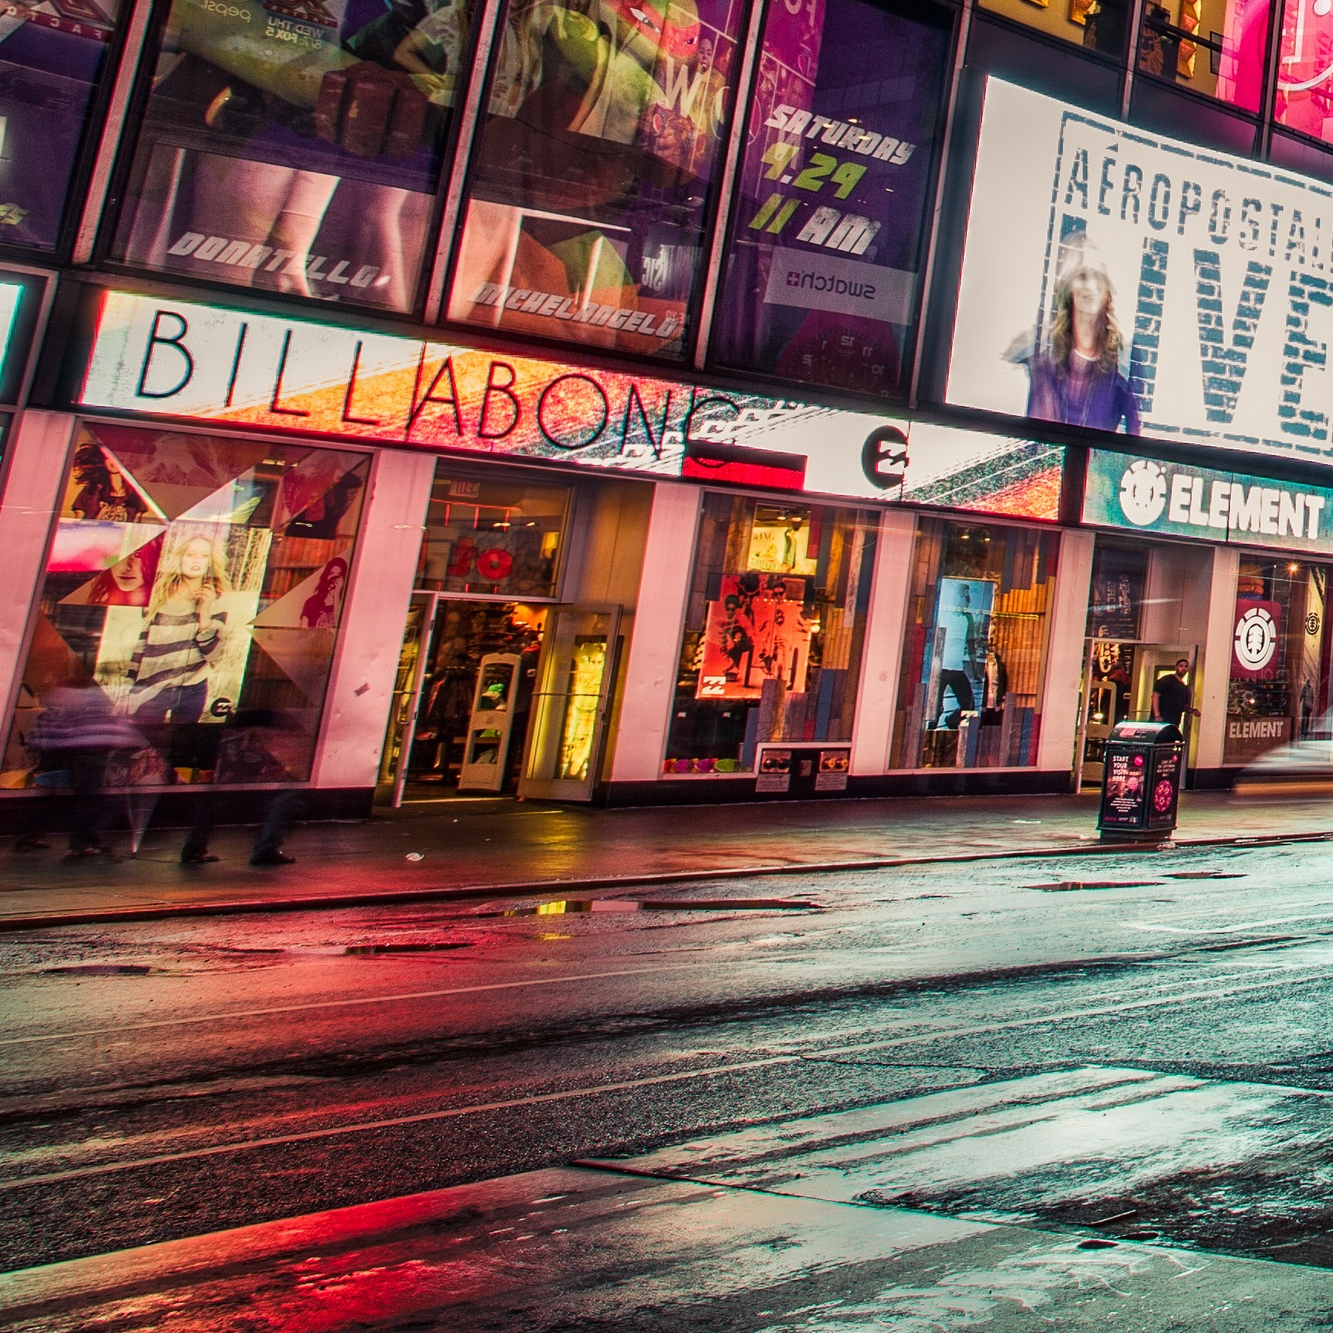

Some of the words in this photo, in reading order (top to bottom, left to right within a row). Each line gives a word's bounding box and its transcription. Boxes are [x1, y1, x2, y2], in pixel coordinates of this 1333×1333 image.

[764, 103, 918, 166] SATURDAY
[761, 141, 867, 201] 9.29
[748, 193, 801, 235] 11
[797, 204, 882, 256] AM
[167, 231, 380, 288] DONATELLO
[472, 280, 679, 339] MICHELANGELO
[137, 309, 742, 466] BILLABONG
[1169, 477, 1326, 541] ELEMENT
[1229, 721, 1285, 739] ELEMENT
